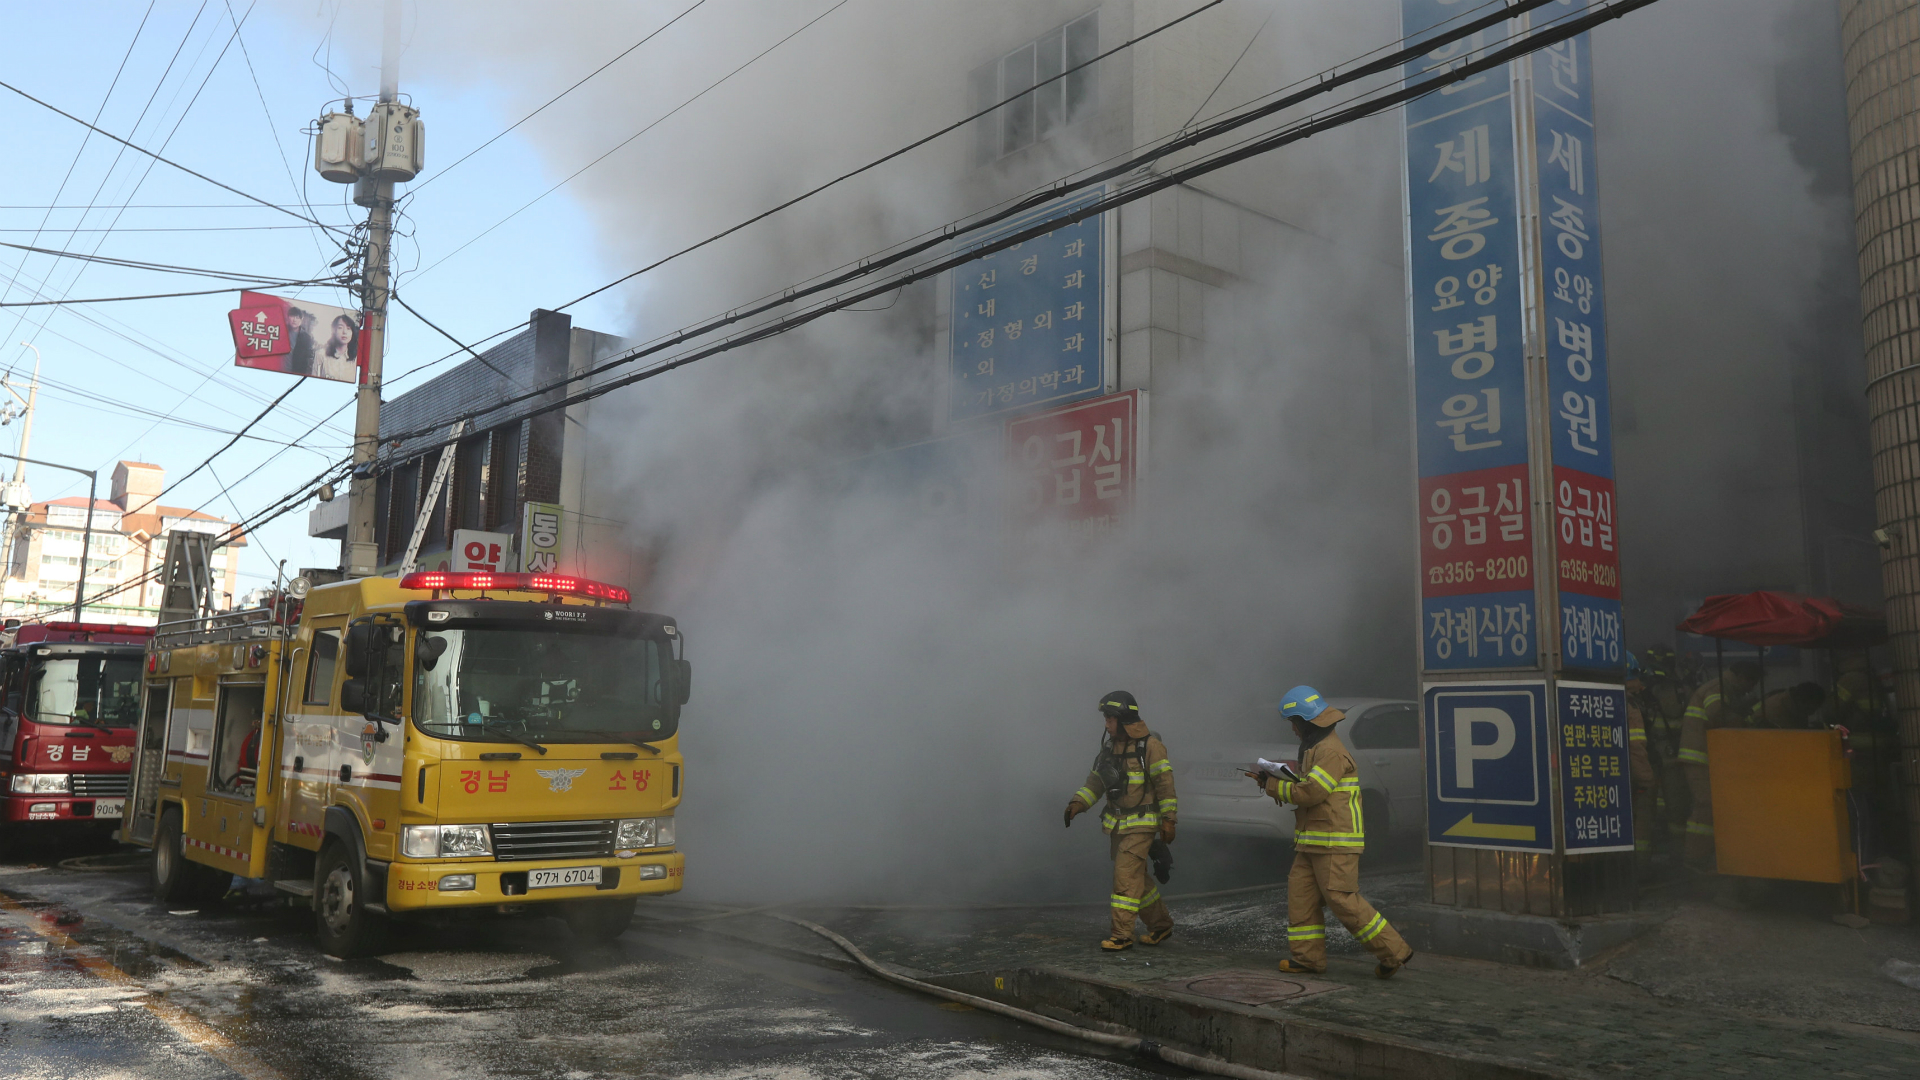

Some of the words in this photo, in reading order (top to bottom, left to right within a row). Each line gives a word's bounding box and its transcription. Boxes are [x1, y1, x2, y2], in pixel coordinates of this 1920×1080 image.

[240, 321, 280, 340] 전도연
[246, 337, 272, 352] 거리
[976, 364, 1086, 406] 가정의학과
[1022, 418, 1123, 513] 응급실
[1426, 478, 1525, 550] 응급실
[1558, 480, 1614, 552] 응급실
[1444, 555, 1529, 585] 356-8200
[1569, 558, 1616, 588] 356-8200
[1430, 603, 1532, 660] 장례식장
[1563, 605, 1620, 663] 장례식장
[1569, 694, 1615, 718] 주차장은
[46, 744, 91, 761] 경남
[1453, 707, 1516, 789] P
[1569, 755, 1592, 778] 넓은
[1598, 755, 1621, 778] 무료
[459, 769, 511, 794] 경남
[608, 769, 651, 792] 소방
[1573, 785, 1619, 809] 주차장이
[1575, 815, 1621, 840] 있습니다
[535, 871, 559, 886] 97거
[564, 868, 595, 884] 6704
[668, 866, 685, 877] 밀양
[398, 879, 416, 891] 경남
[417, 879, 438, 891] 소방
